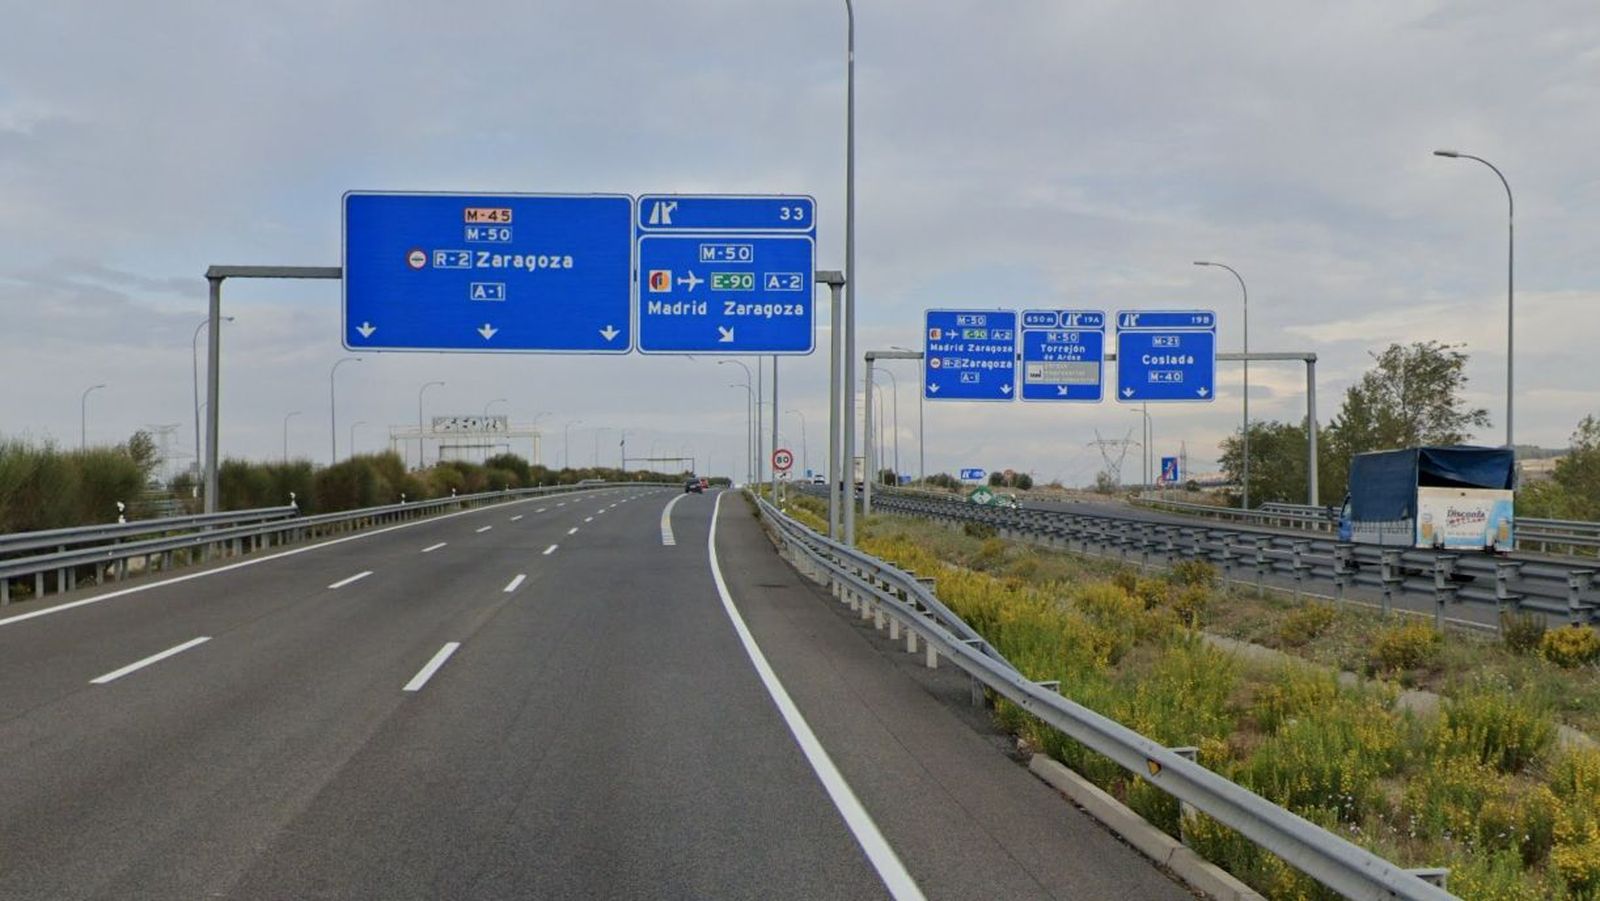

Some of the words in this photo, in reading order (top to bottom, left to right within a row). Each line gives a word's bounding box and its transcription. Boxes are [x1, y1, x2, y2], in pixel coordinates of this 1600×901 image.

[466, 210, 511, 222] M-45
[779, 207, 804, 220] 33
[466, 228, 511, 241] M-50
[702, 247, 750, 260] M-50
[436, 252, 470, 266] R-2
[476, 252, 574, 272] Zaragoza
[712, 275, 752, 288] E-90
[767, 275, 801, 289] A-2
[474, 286, 504, 299] A-1
[648, 301, 707, 315] Madrid
[723, 302, 804, 319] Zaragoza
[993, 331, 1011, 340] A-2
[1049, 332, 1078, 342] M-50
[930, 343, 964, 352] Madrid
[967, 344, 1013, 354] Zaragoza
[961, 359, 1013, 370] Zaragoza
[1142, 354, 1194, 365] Coslada
[1150, 372, 1182, 382] M-40
[777, 456, 789, 464] 80
